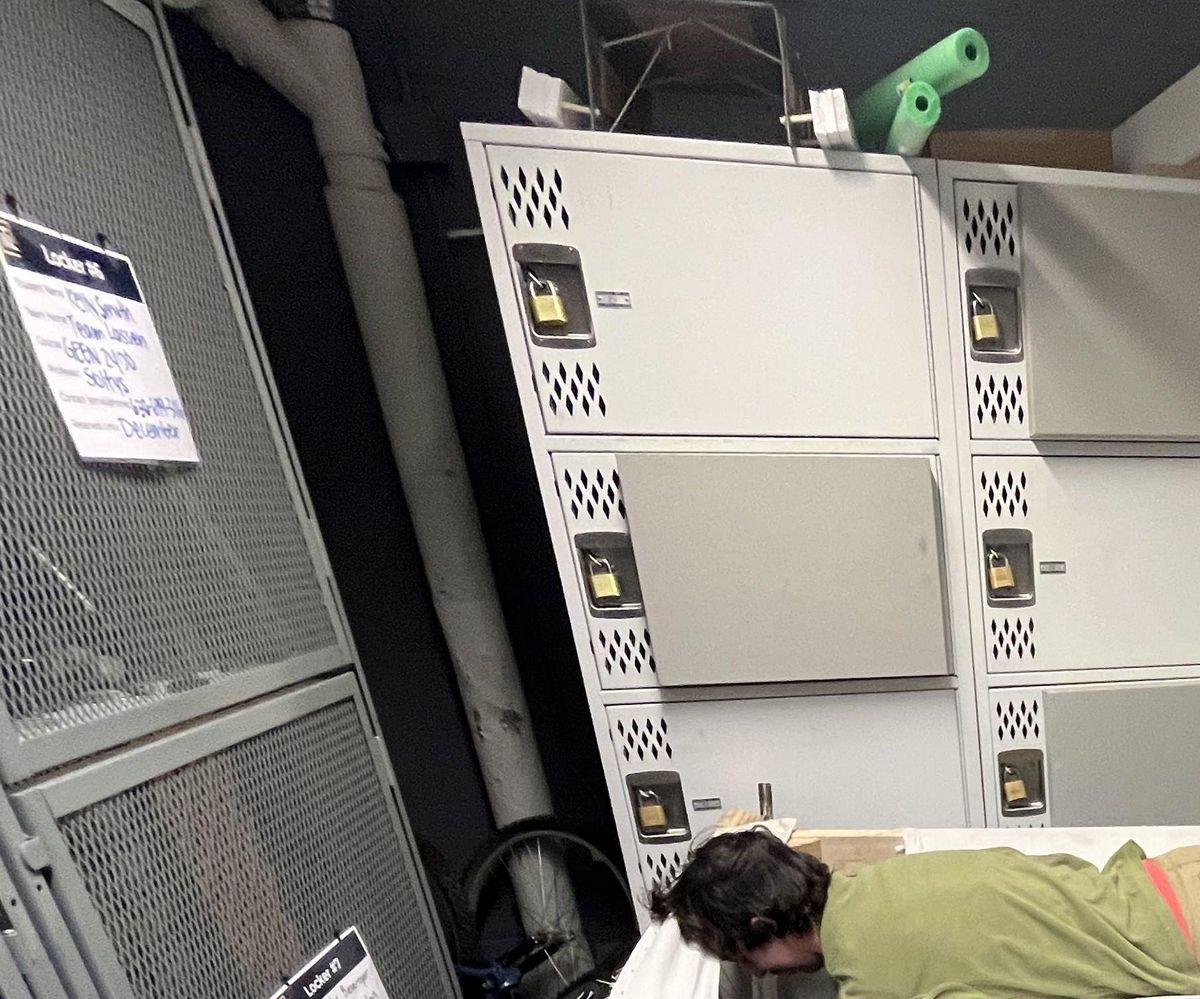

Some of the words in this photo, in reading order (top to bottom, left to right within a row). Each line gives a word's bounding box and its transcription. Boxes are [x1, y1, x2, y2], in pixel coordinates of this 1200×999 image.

[39, 244, 87, 275] Locker
[66, 315, 104, 341] Team
[302, 968, 332, 998] Locker
[329, 957, 342, 974] #7
